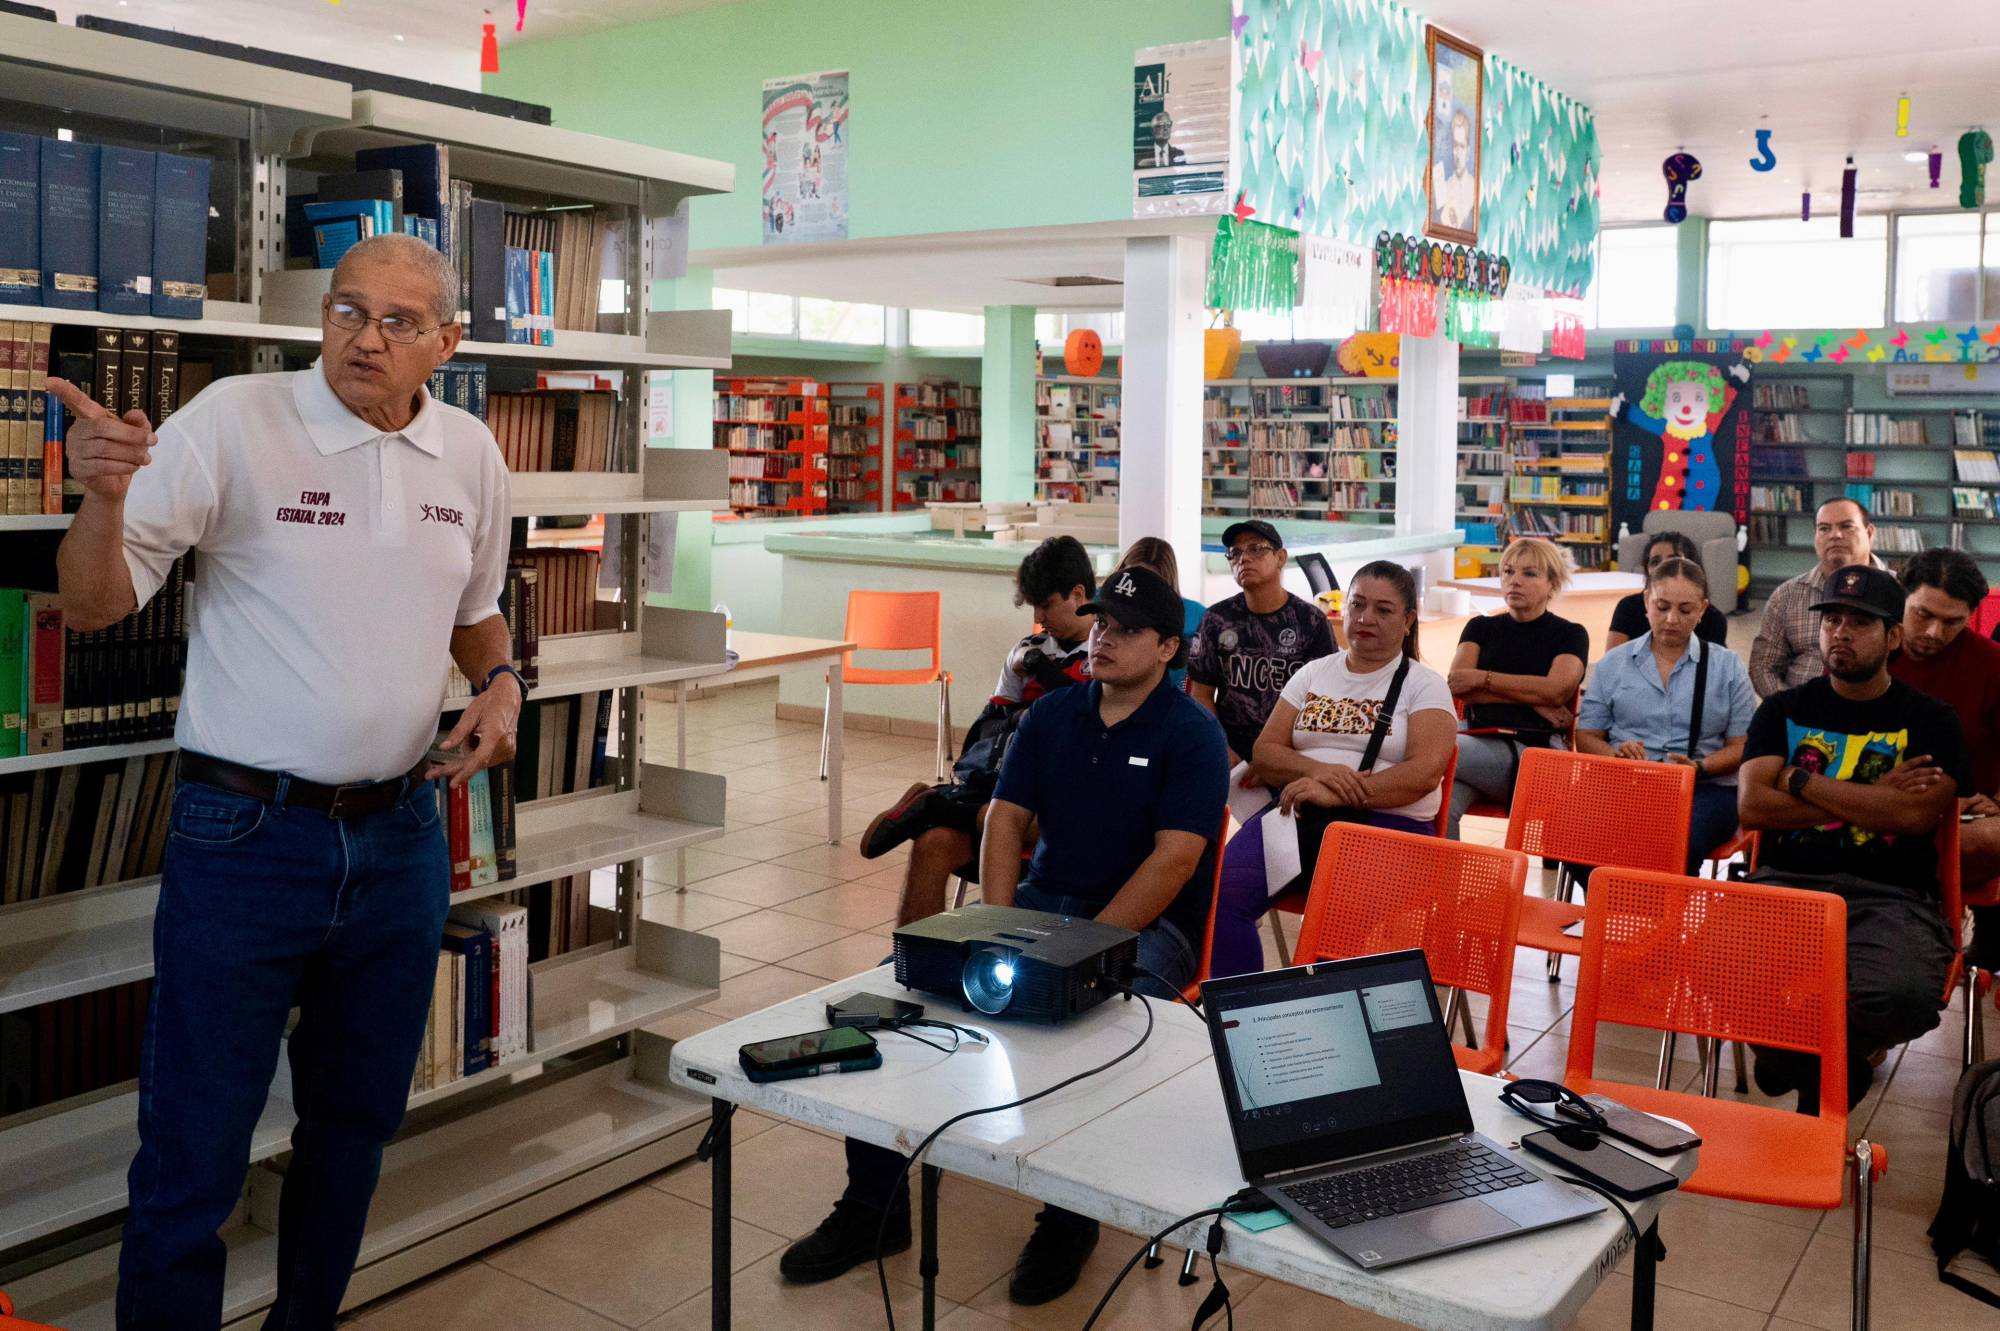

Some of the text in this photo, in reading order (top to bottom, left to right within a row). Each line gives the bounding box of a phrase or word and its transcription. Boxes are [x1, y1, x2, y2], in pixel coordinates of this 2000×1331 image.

[1140, 72, 1172, 98] Alí
[300, 491, 331, 506] ETAPA
[276, 507, 346, 526] ESTATAL 2024
[436, 505, 464, 527] ISDE
[1115, 572, 1136, 598] LA
